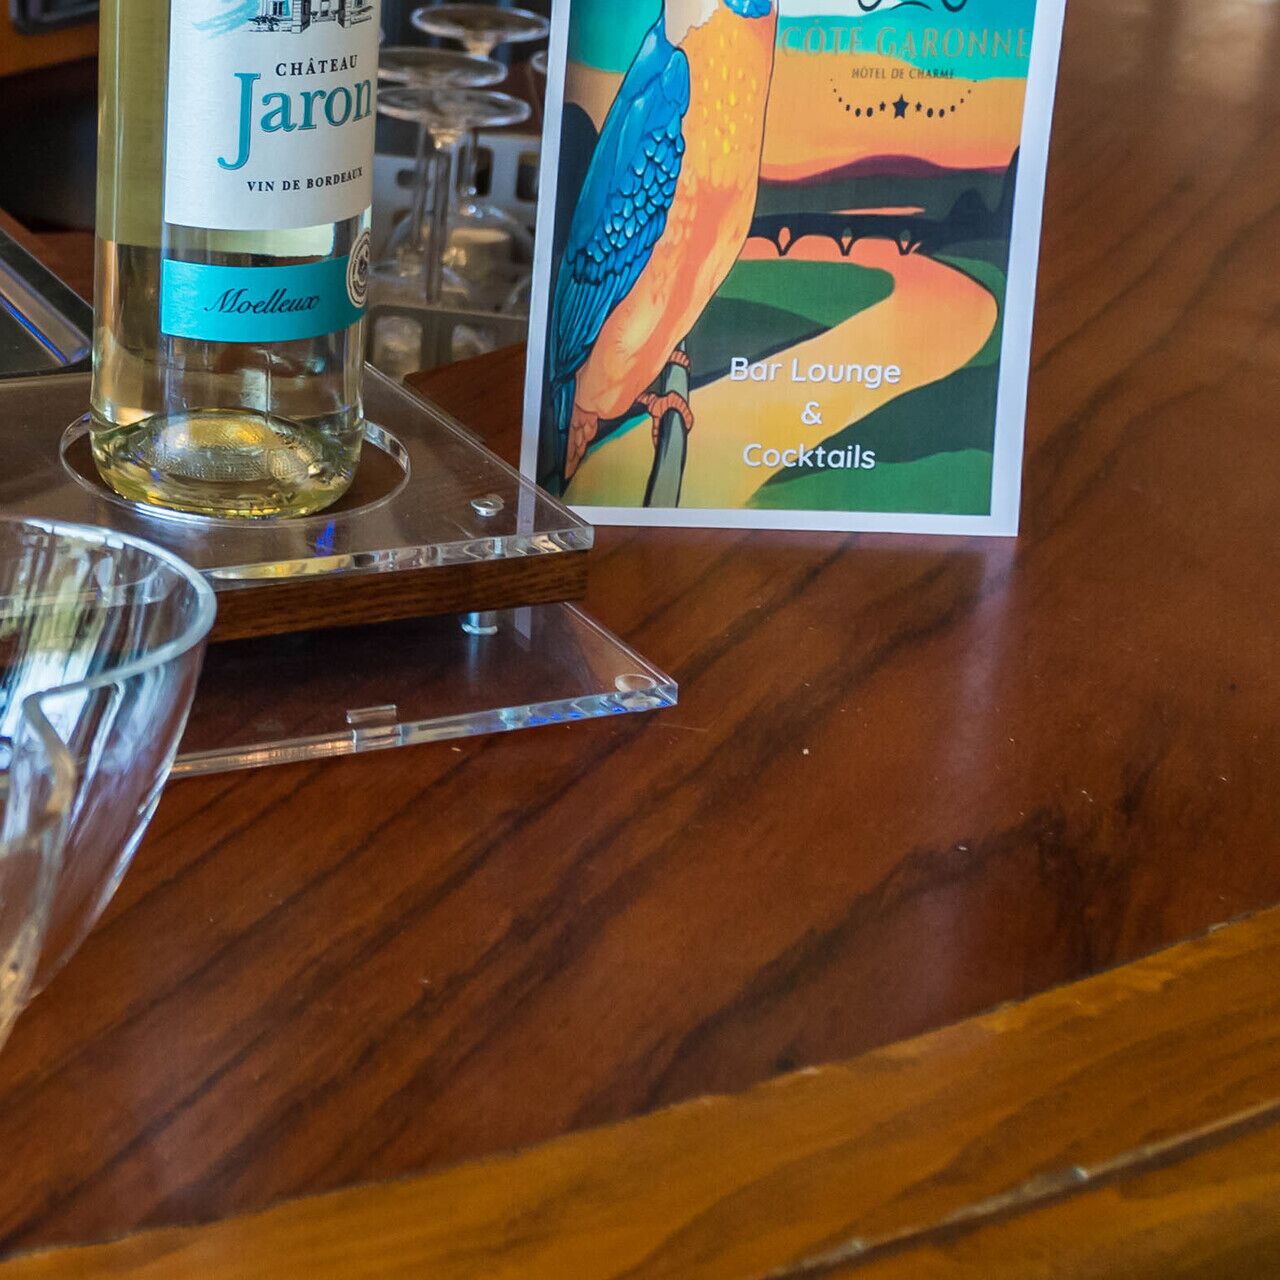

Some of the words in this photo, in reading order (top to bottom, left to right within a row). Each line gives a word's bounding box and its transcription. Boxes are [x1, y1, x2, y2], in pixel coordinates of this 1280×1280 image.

[780, 18, 864, 58] CÔTÉ
[876, 25, 1032, 59] GARONNE
[275, 55, 358, 77] CHÂTEAU
[851, 66, 887, 80] HÔTEL
[890, 67, 906, 80] DE
[908, 67, 956, 80] CHARME
[216, 72, 372, 171] Jaron
[247, 181, 275, 192] VIN
[282, 180, 301, 191] DE
[306, 166, 363, 190] BORDEAUX
[204, 287, 320, 314] Moelleux
[730, 356, 783, 382] Bar
[791, 358, 902, 389] Lounge
[800, 400, 823, 425] &
[742, 443, 877, 470] Cocktails
